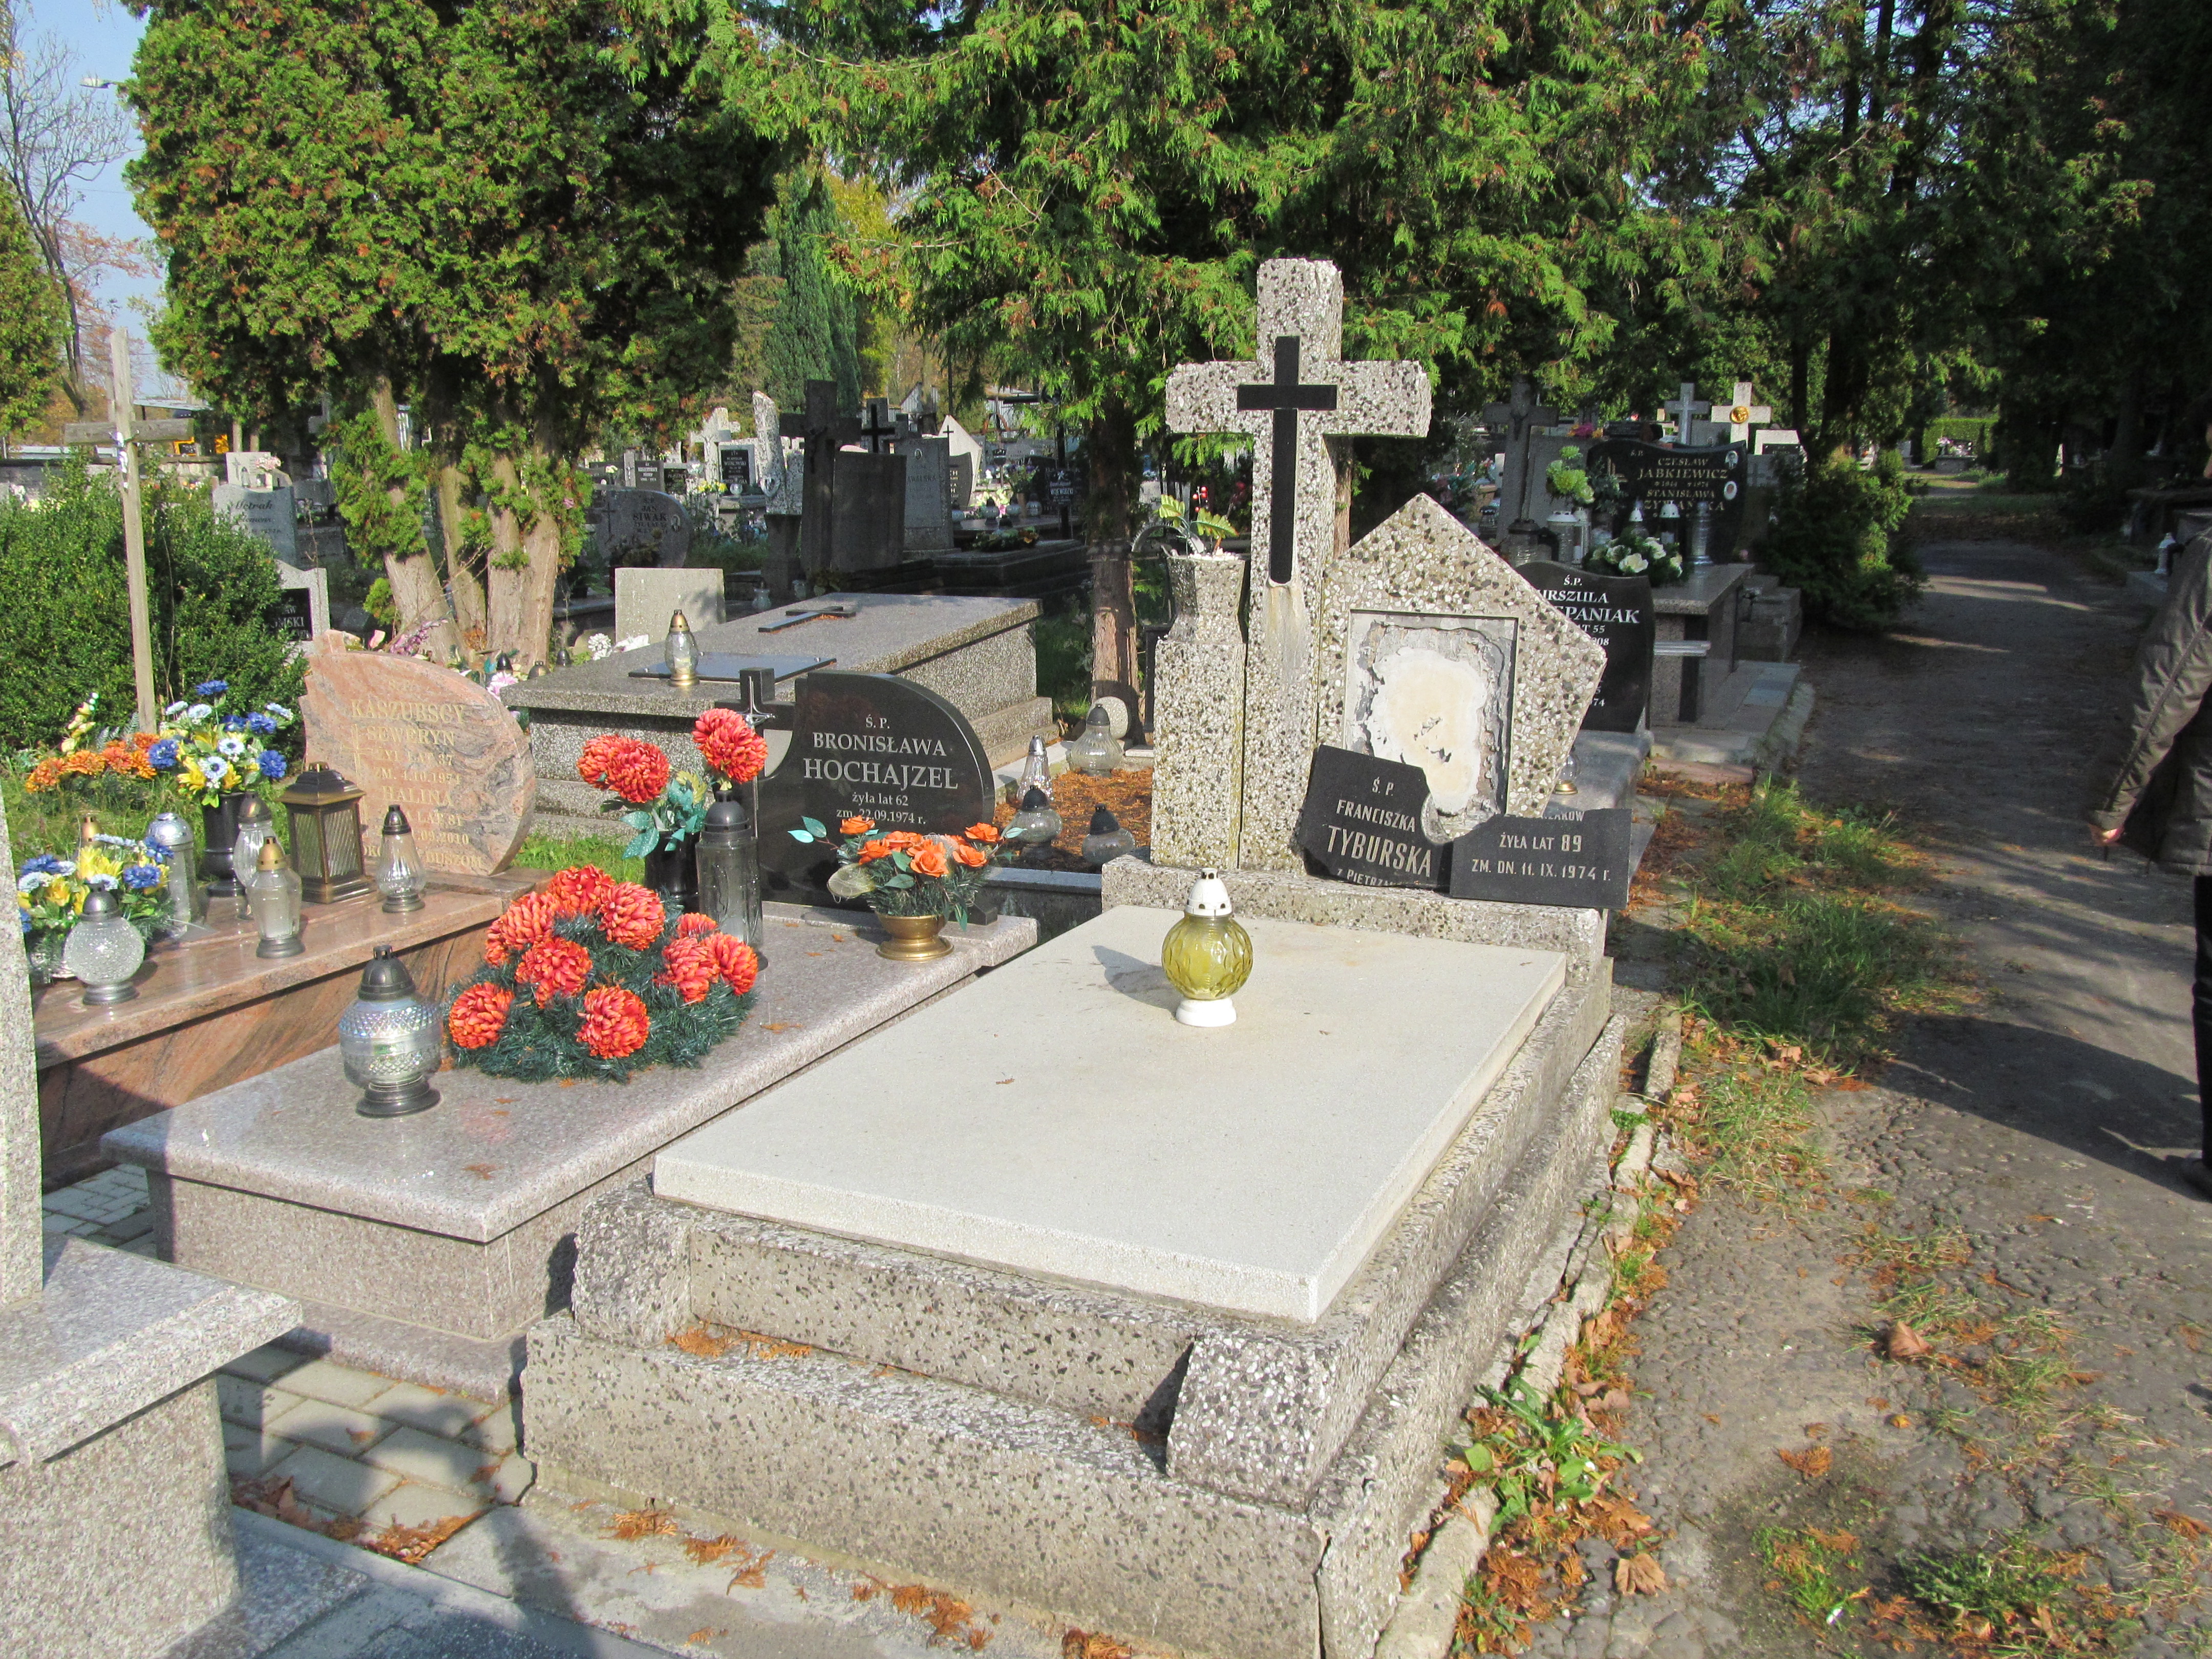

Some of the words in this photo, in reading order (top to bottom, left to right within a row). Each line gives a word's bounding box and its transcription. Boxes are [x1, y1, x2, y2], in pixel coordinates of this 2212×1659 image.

[1657, 458, 1709, 466] CZESŁAW
[1636, 468, 1729, 480] JABKIEWICZ
[1646, 489, 1715, 498] STANISŁAWA
[633, 513, 668, 521] SIWAK
[1592, 625, 1606, 633] 55
[350, 699, 465, 724] KASZUBSCY
[367, 726, 455, 746] SEWERYN
[813, 732, 947, 757] BRONISŁAWA
[438, 753, 454, 766] 37
[803, 758, 959, 791] HOCHAJZEL
[382, 785, 453, 806] HALINA
[852, 792, 875, 806] żyła
[878, 793, 892, 806] lat
[896, 795, 909, 806] 62
[836, 810, 854, 819] zm.
[858, 807, 915, 824] 22.09.1974
[917, 817, 926, 825] r.
[1336, 799, 1415, 833] FRANCISZKA
[1327, 825, 1431, 878] TYBURSKA
[1499, 832, 1527, 849] ŻYŁA
[1533, 836, 1555, 850] LAT
[1561, 834, 1582, 853] 89
[1472, 859, 1492, 873] ZM.
[1497, 860, 1517, 875] DN.
[1522, 862, 1535, 876] 11.
[1540, 863, 1557, 877] IX.
[1562, 865, 1597, 880] 1974
